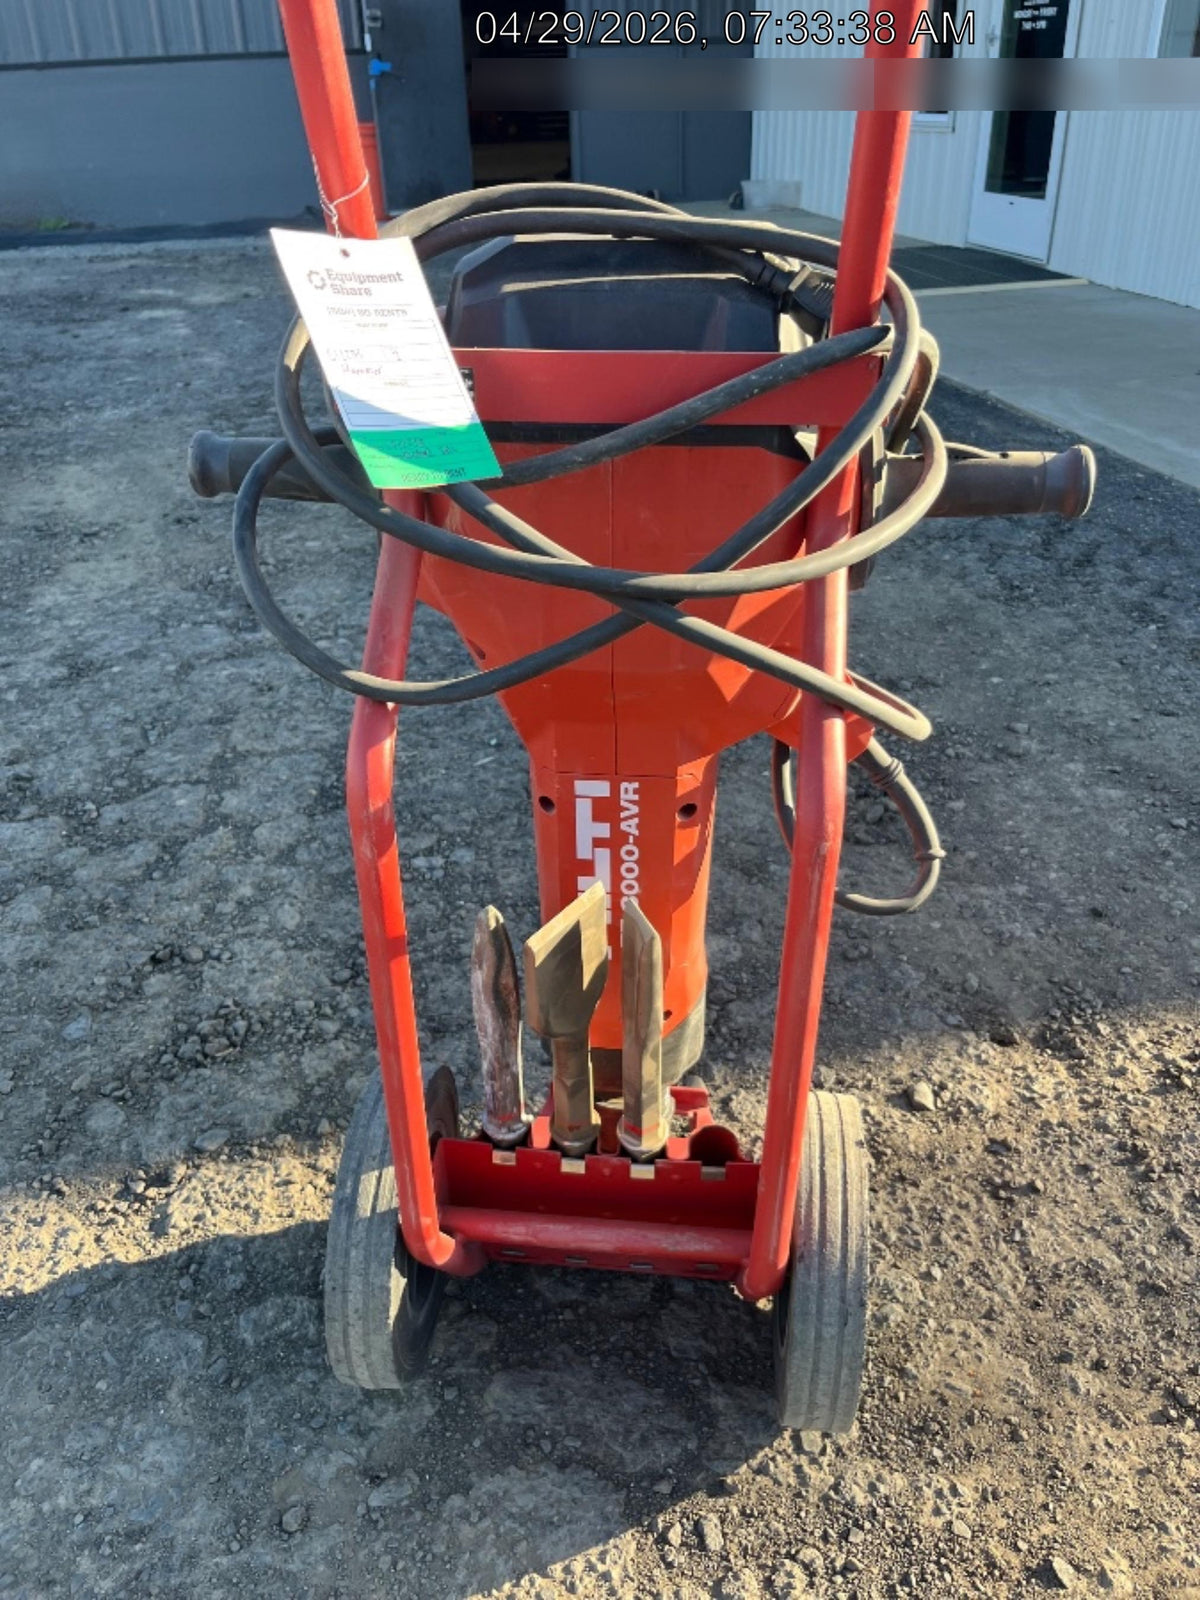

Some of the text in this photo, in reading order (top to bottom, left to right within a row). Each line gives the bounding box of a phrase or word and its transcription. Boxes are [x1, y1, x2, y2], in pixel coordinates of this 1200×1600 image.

[325, 268, 404, 286] Equipment
[330, 284, 373, 297] Share
[573, 780, 612, 960] LTI
